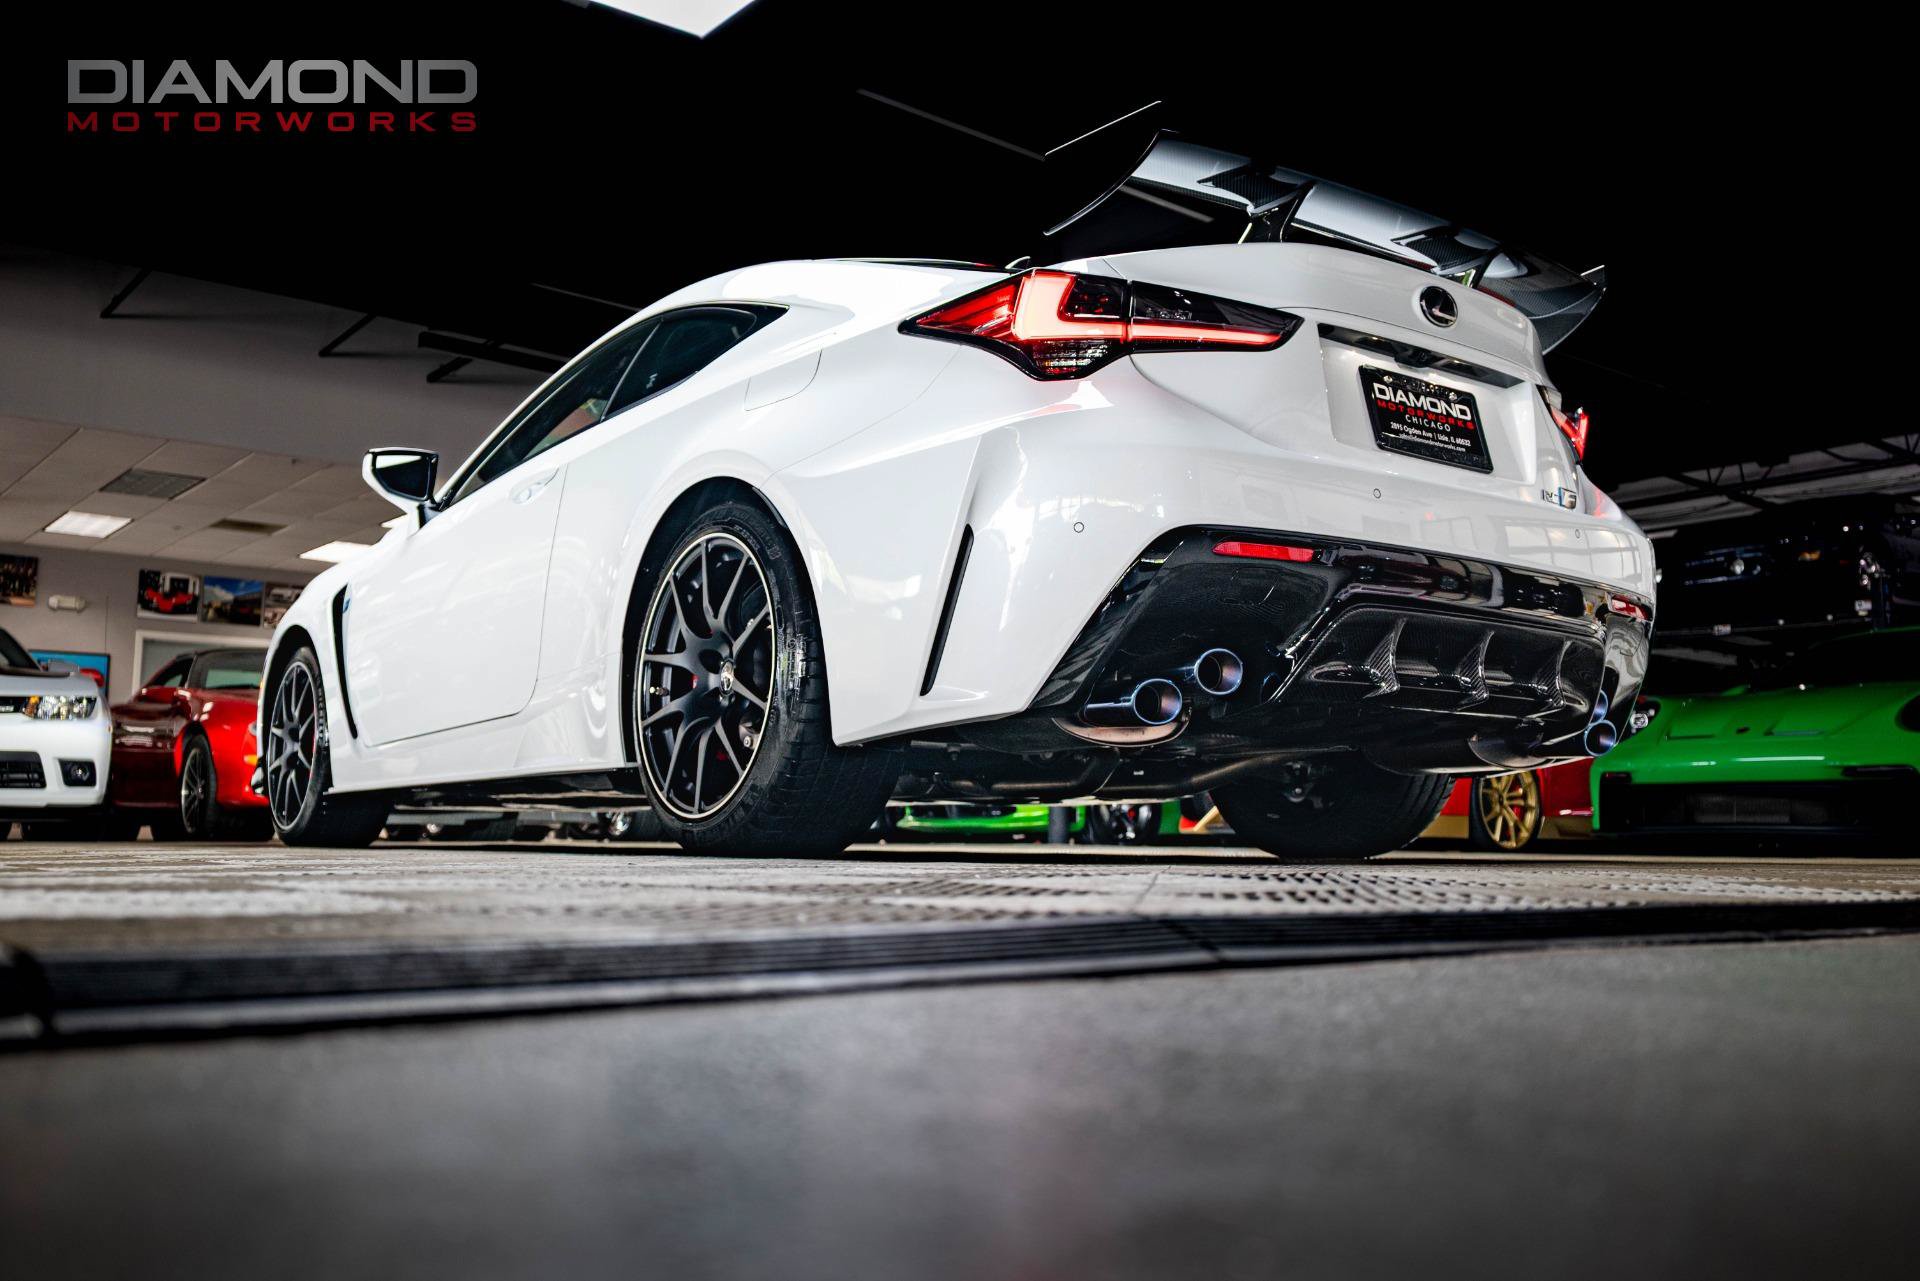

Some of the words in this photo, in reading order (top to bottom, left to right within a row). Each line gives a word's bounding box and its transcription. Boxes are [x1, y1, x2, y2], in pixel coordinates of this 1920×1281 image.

[1373, 382, 1472, 421] DIAMOND
[1377, 399, 1475, 430] MOTORWORKS
[1405, 414, 1451, 432] CHICAGO
